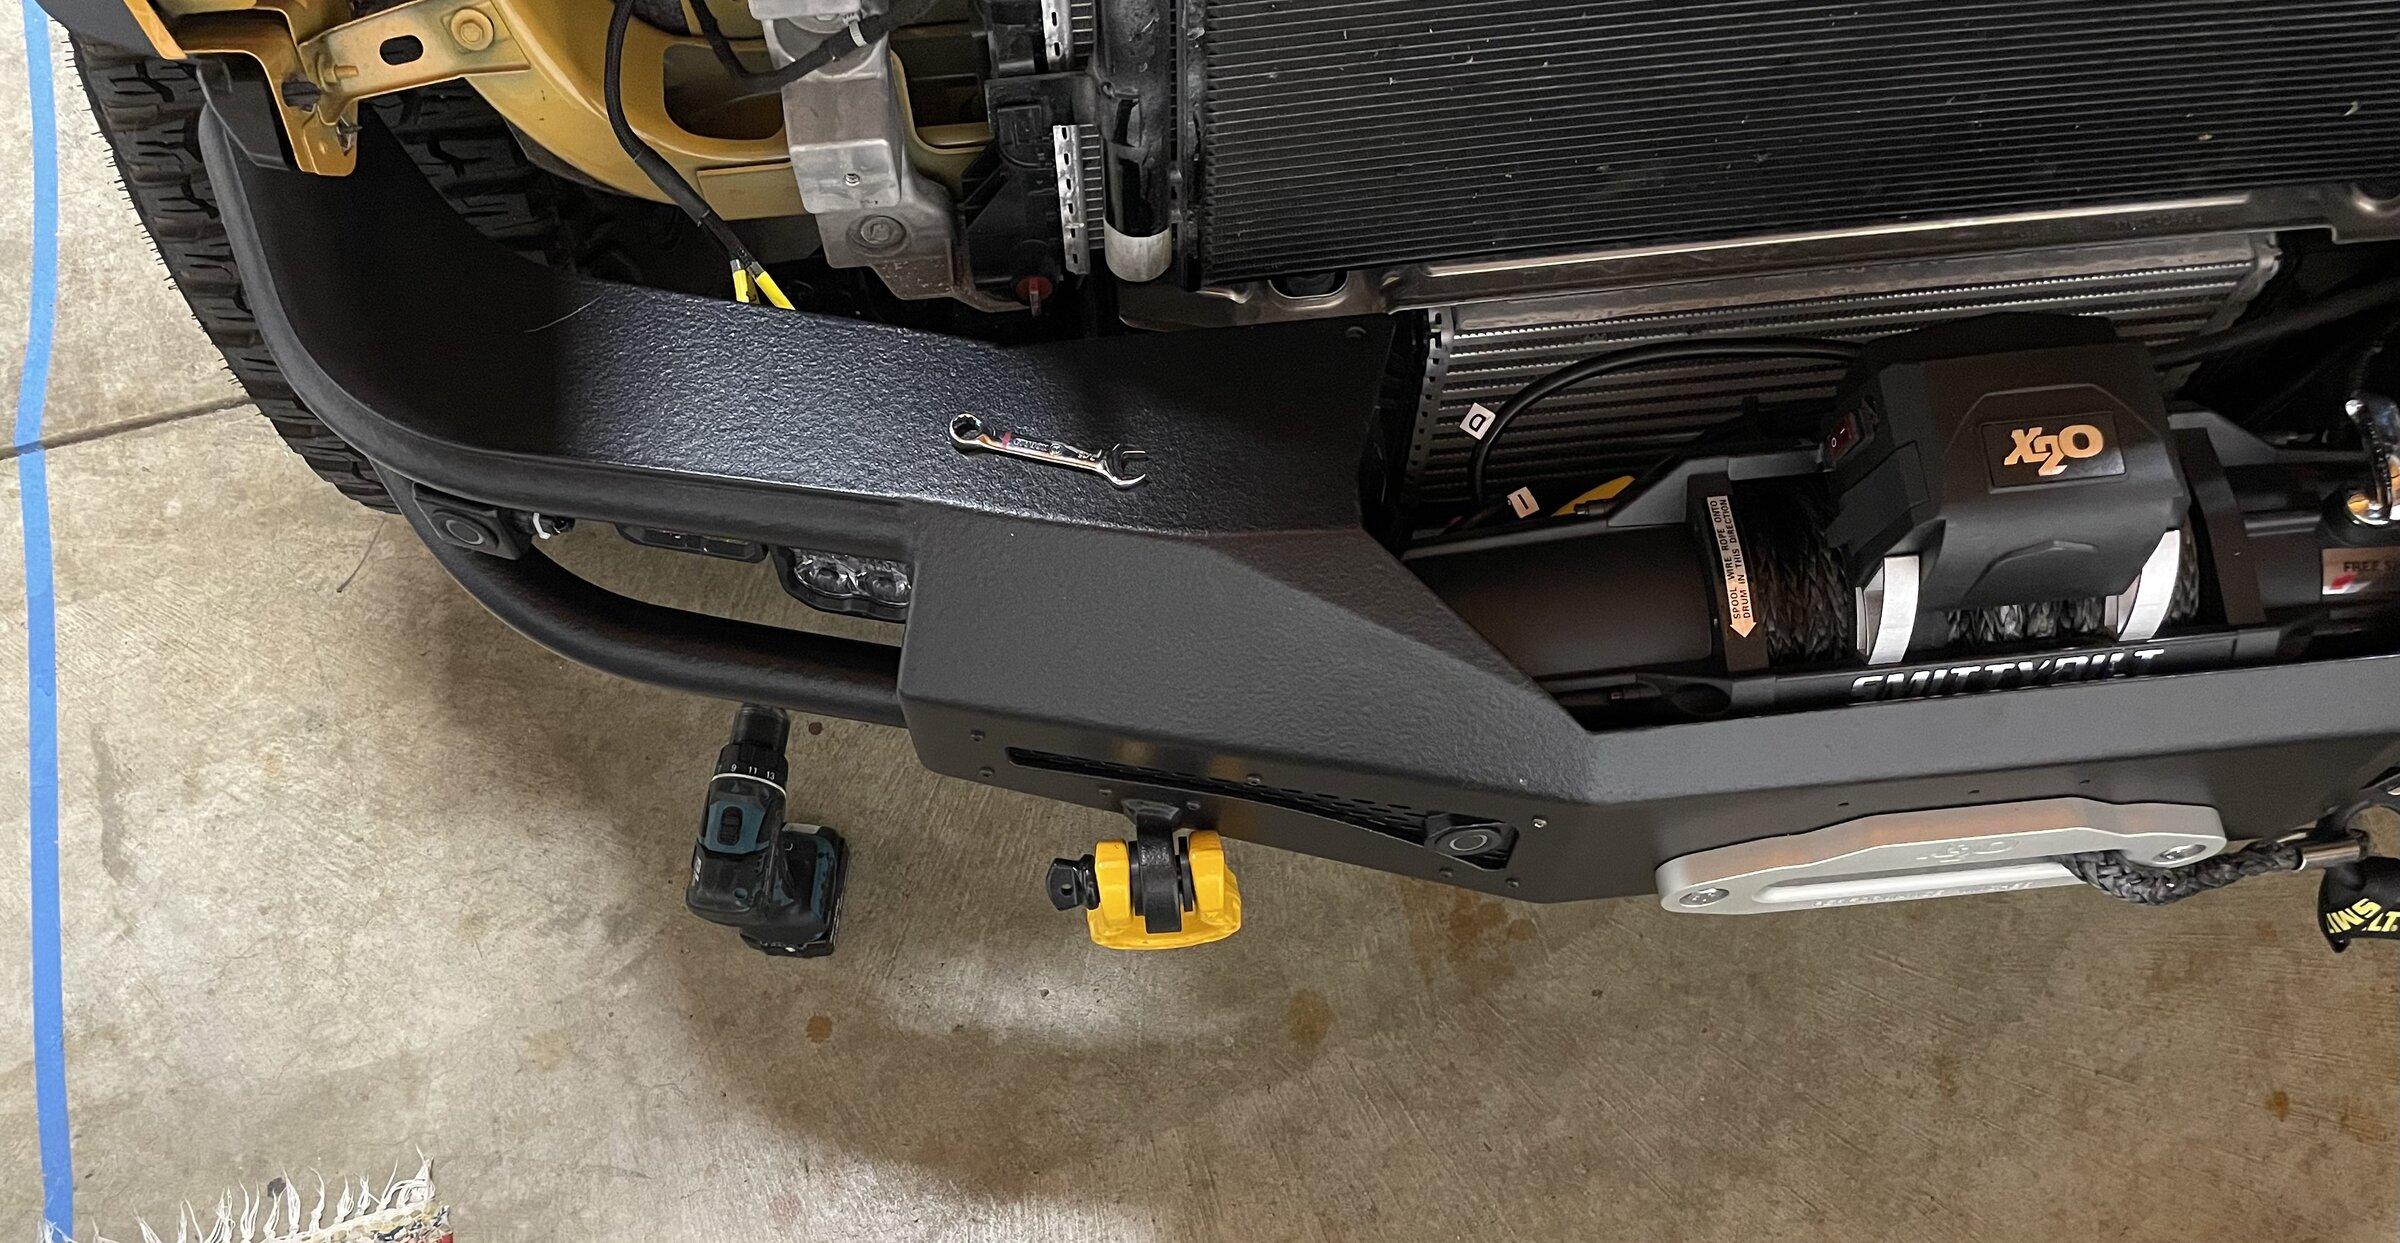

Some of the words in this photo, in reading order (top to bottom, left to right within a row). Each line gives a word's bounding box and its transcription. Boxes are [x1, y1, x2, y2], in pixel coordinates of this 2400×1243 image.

[1710, 500, 1722, 523] ONTO
[1719, 499, 1738, 543] DIRECTION
[1718, 528, 1729, 551] ROPE
[1724, 556, 1735, 581] WIRE
[1733, 548, 1743, 569] THIS
[1737, 574, 1746, 585] IN
[1729, 587, 1741, 619] SPOOL
[1740, 589, 1751, 619] DRUM
